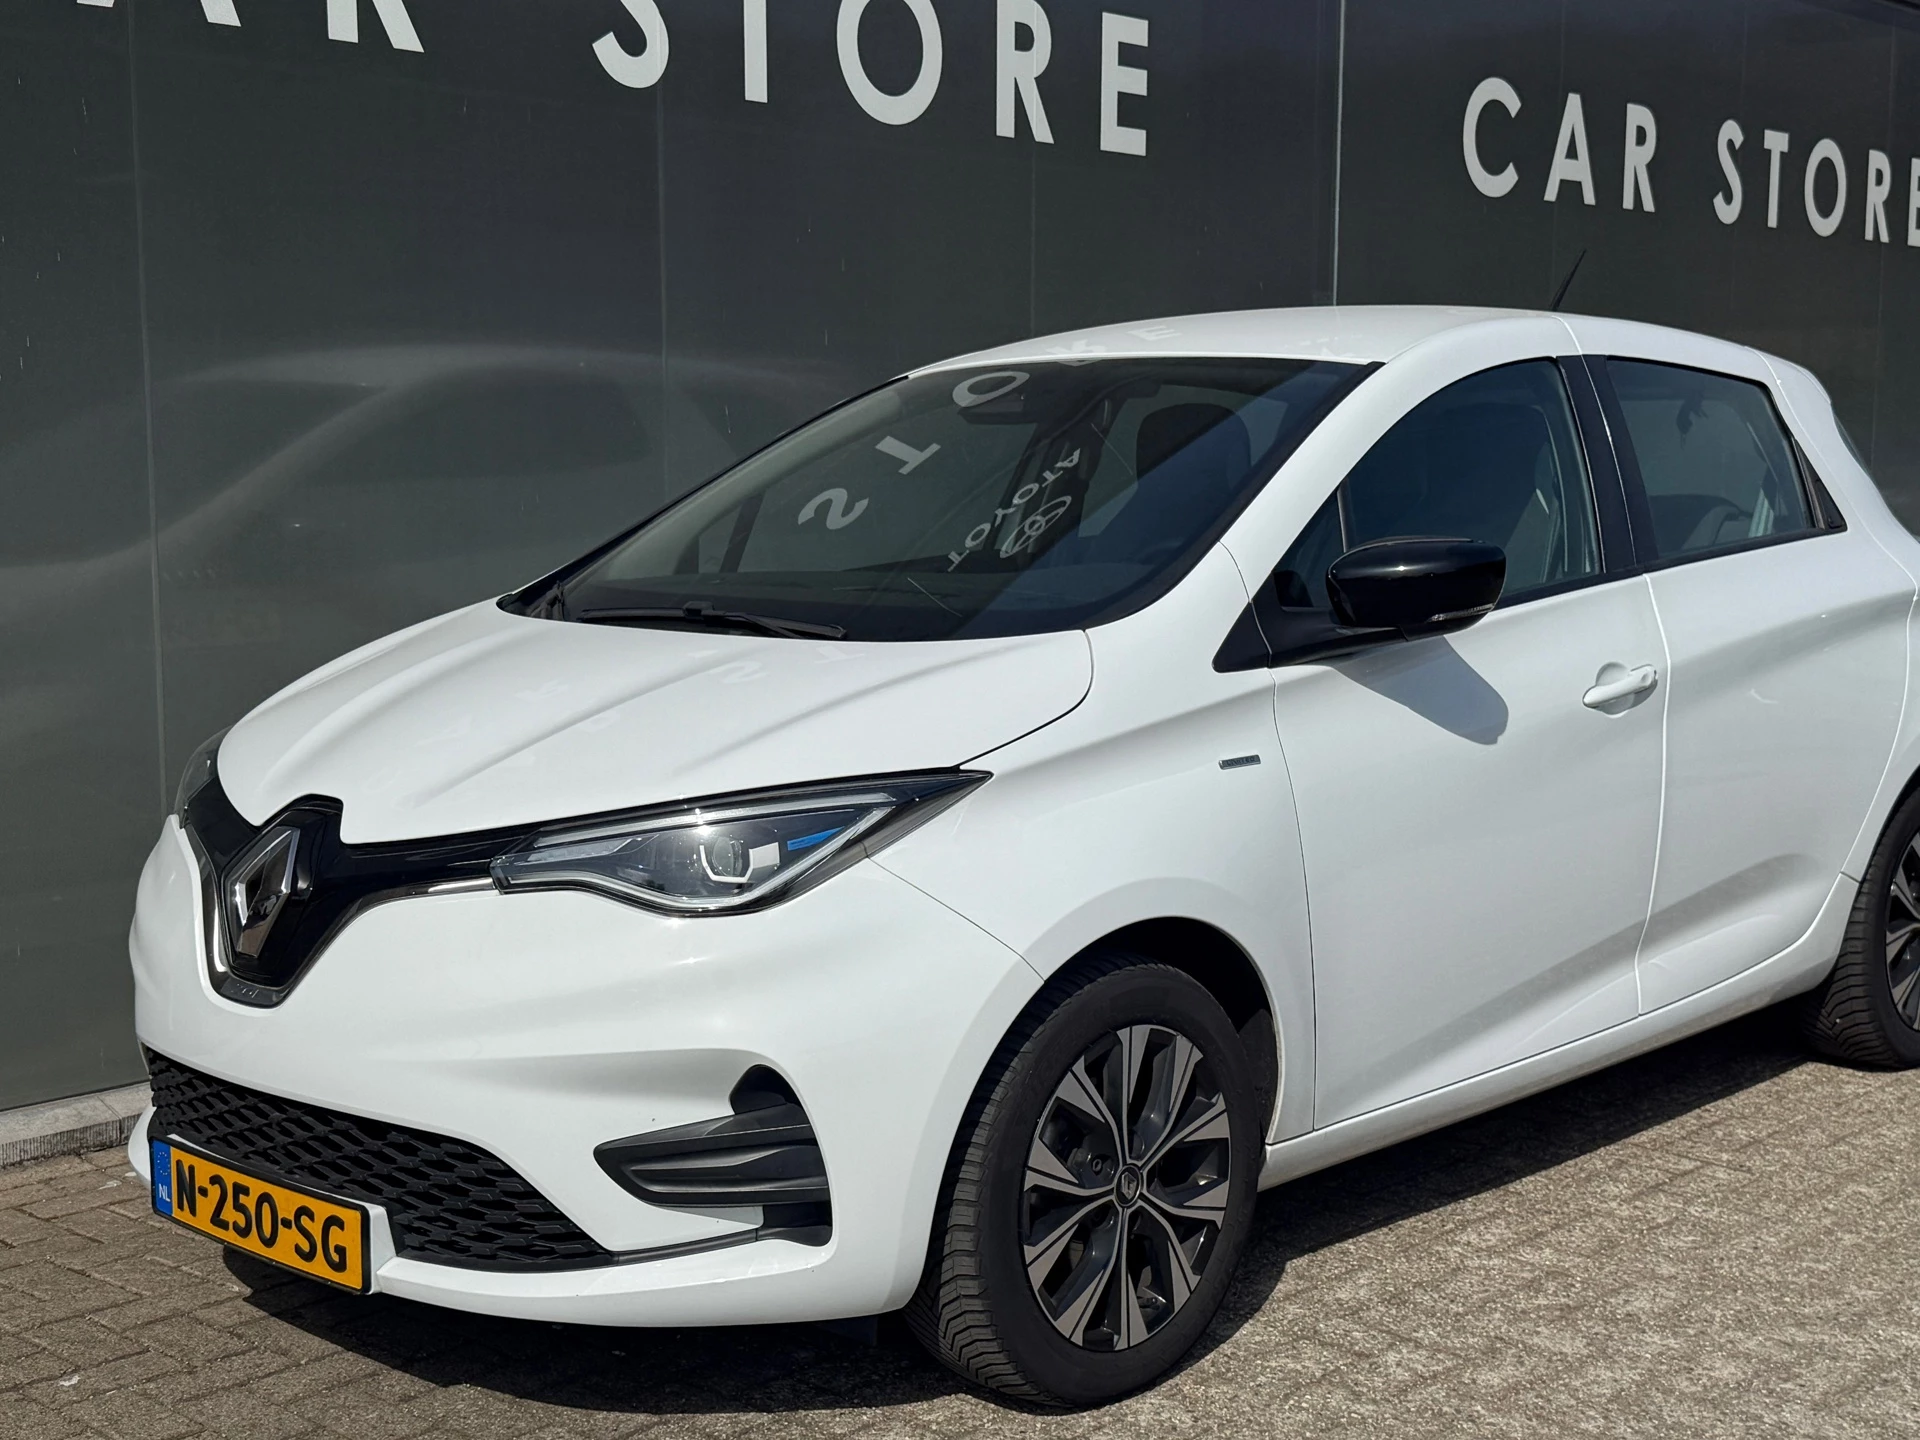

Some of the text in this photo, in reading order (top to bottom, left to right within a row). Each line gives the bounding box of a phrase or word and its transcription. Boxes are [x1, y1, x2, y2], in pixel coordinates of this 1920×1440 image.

[1462, 77, 1920, 248] CAR STORE
[158, 1183, 171, 1202] NL
[176, 1159, 347, 1274] N-250-SG
